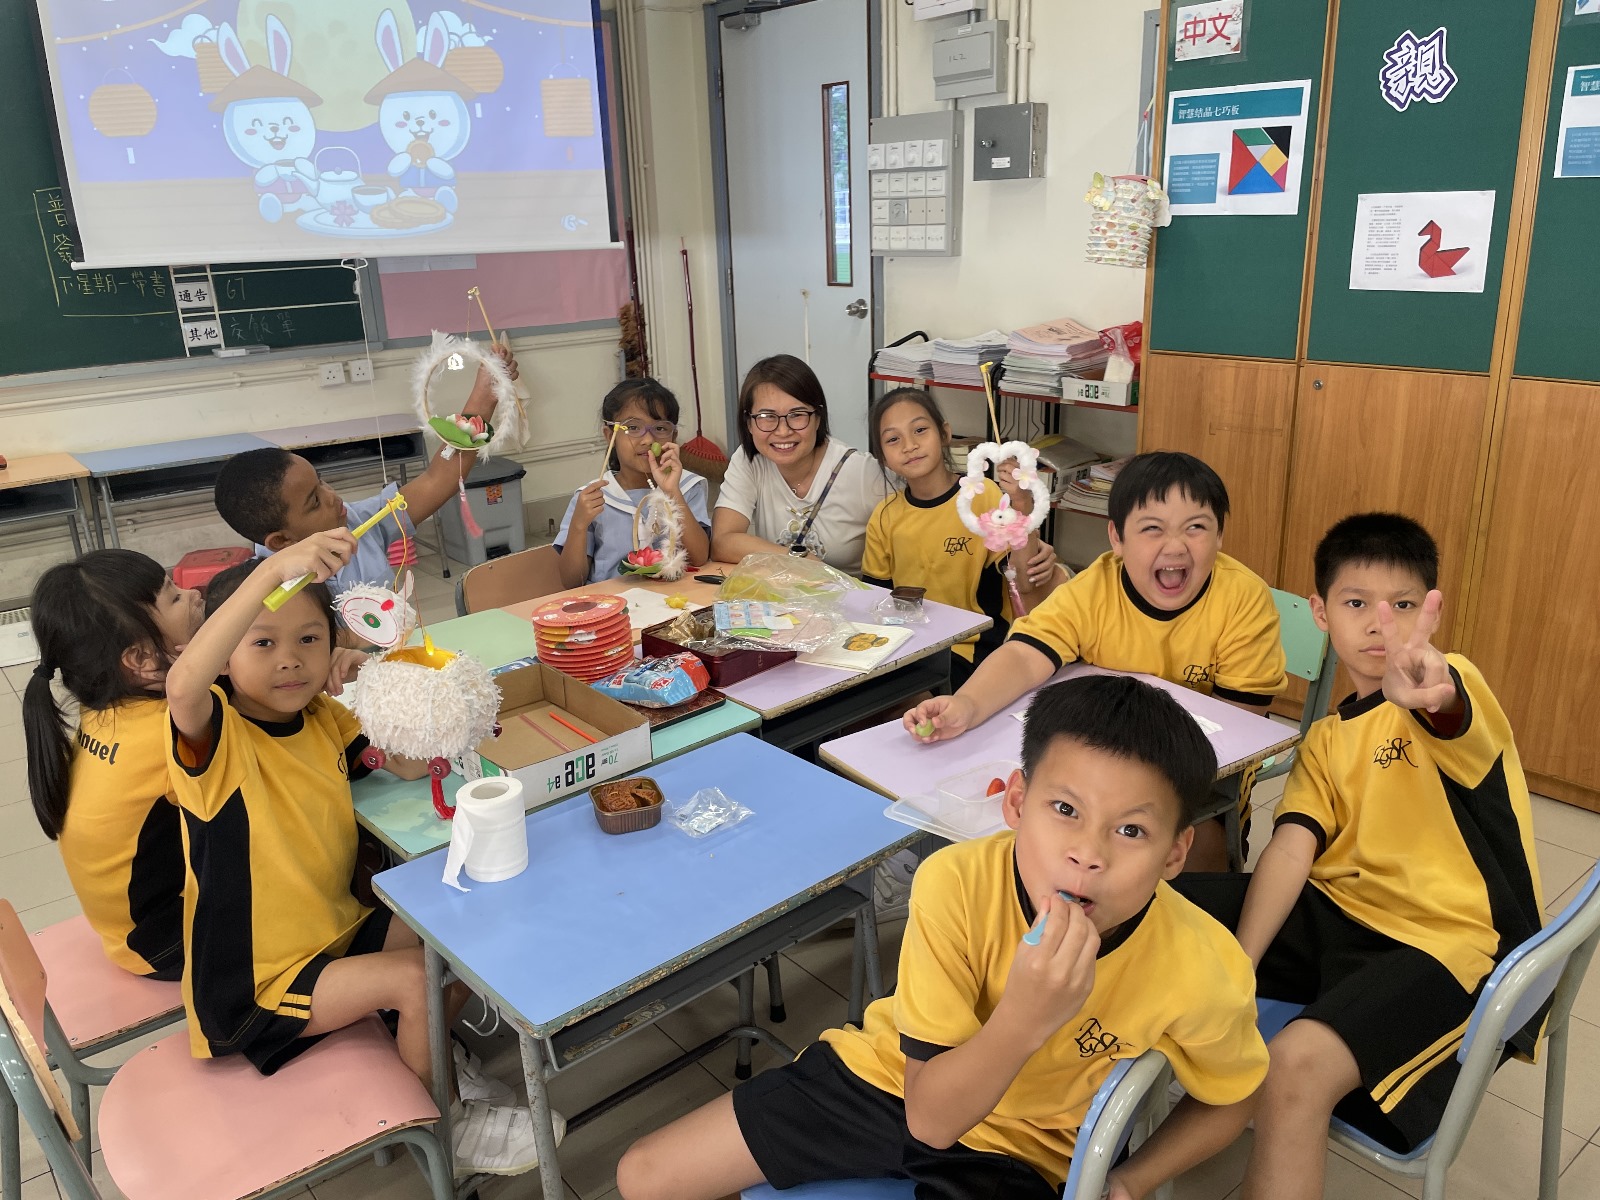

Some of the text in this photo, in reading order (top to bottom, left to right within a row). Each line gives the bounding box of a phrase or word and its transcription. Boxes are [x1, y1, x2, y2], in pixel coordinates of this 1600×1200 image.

[1183, 12, 1232, 46] 中文
[1381, 30, 1456, 108] 親
[178, 288, 208, 303] 通告
[188, 327, 219, 342] 其他
[564, 752, 596, 787] ace
